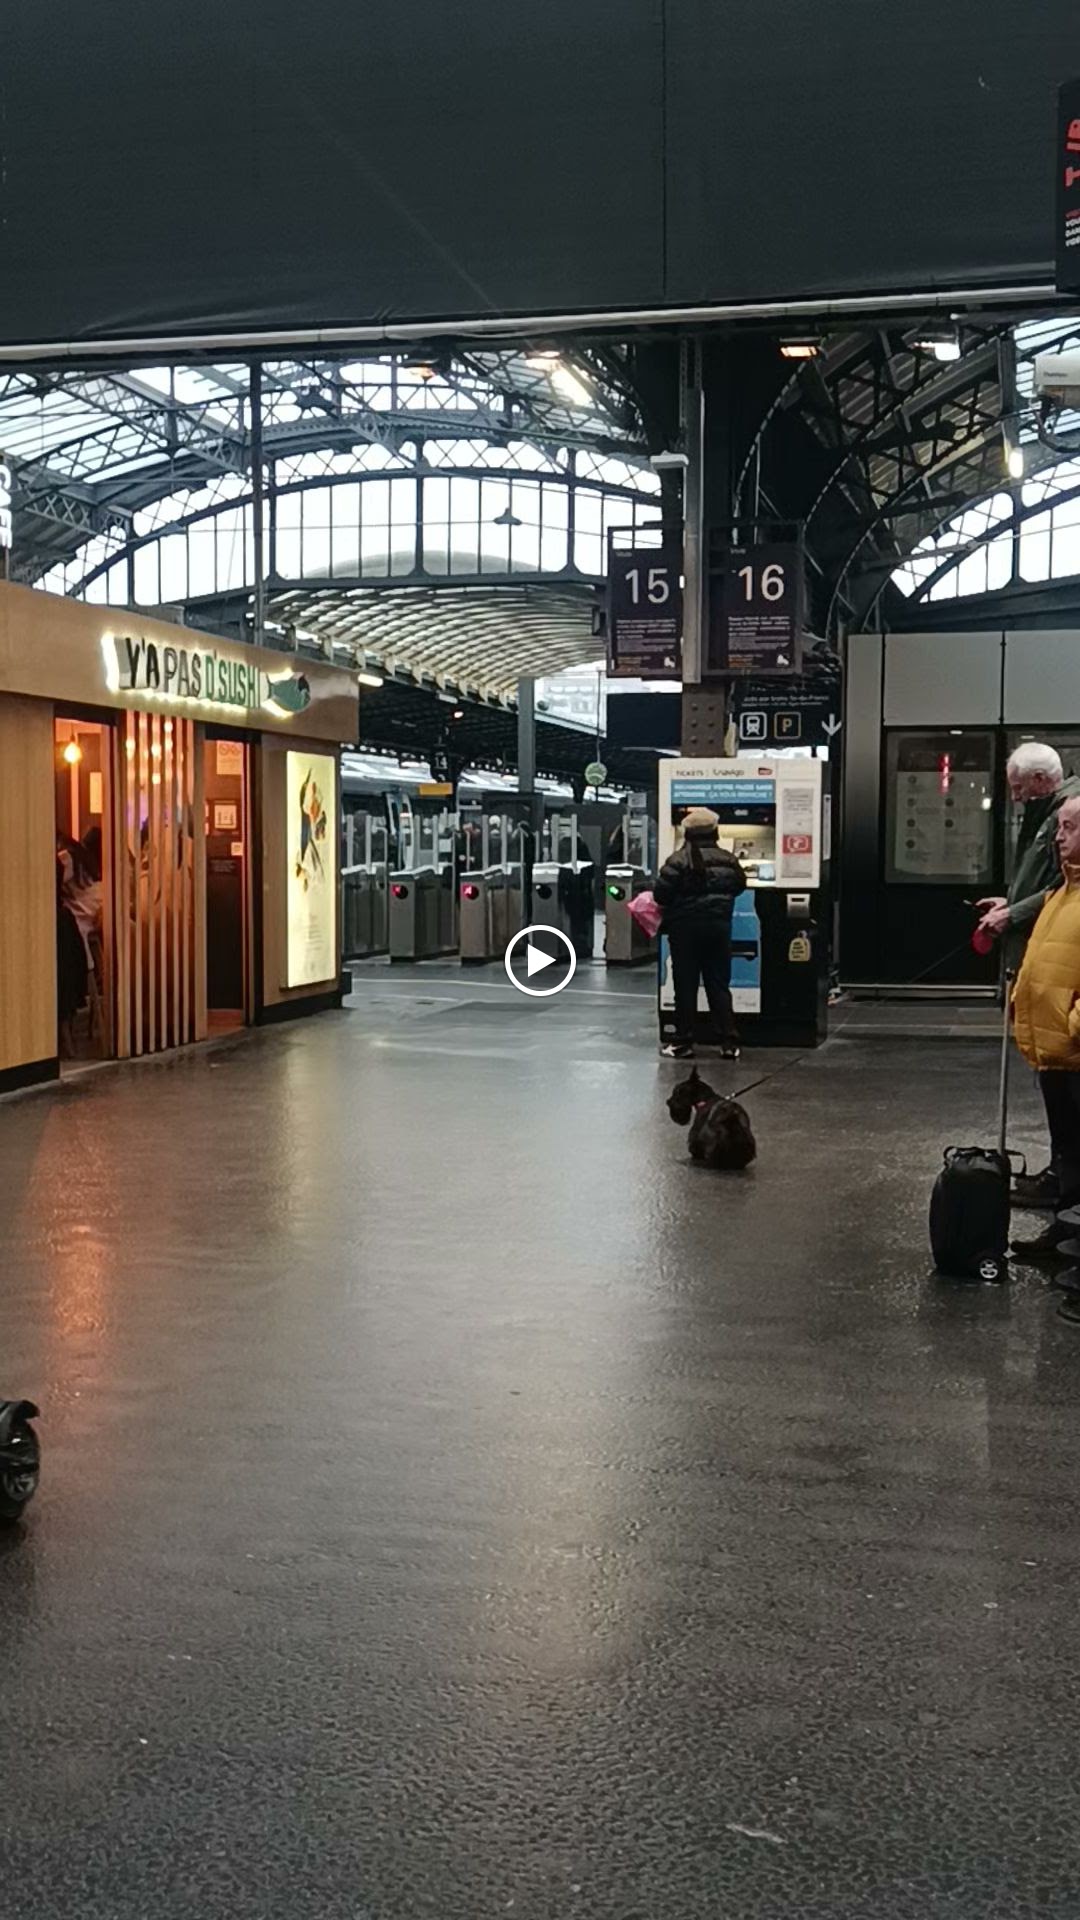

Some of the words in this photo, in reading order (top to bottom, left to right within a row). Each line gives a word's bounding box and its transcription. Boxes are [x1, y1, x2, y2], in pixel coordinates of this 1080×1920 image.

[625, 568, 669, 604] 15
[738, 564, 784, 601] 16
[125, 636, 160, 689] Y'A
[164, 647, 201, 698] PAS
[205, 649, 261, 709] D'SUSHI
[782, 718, 792, 732] P
